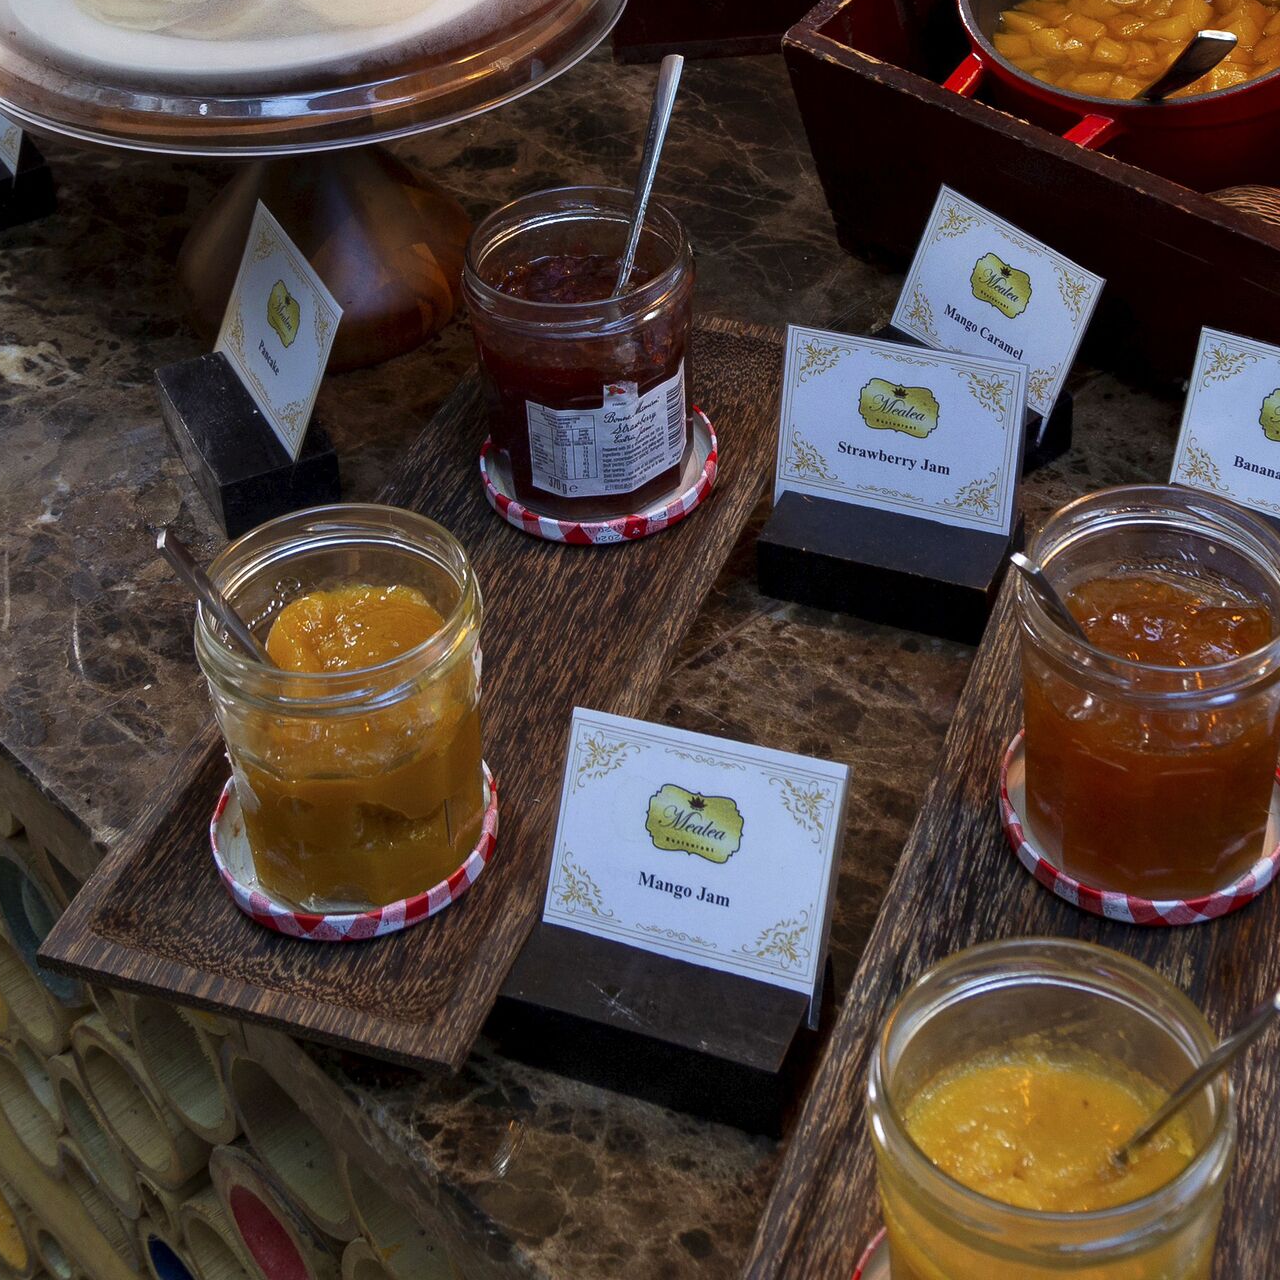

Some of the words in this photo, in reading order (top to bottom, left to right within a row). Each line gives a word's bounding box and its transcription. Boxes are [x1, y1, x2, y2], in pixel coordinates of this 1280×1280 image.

[978, 268, 1020, 303] Mealea
[943, 303, 978, 333] Mango
[979, 326, 1024, 361] Caramel
[258, 338, 280, 376] Pancake
[868, 393, 926, 422] Mealea
[837, 440, 917, 471] Strawberry
[920, 458, 951, 476] Jam
[548, 475, 561, 491] 370
[658, 805, 726, 841] Mealea
[638, 870, 692, 900] Mango
[696, 885, 730, 908] Jam
